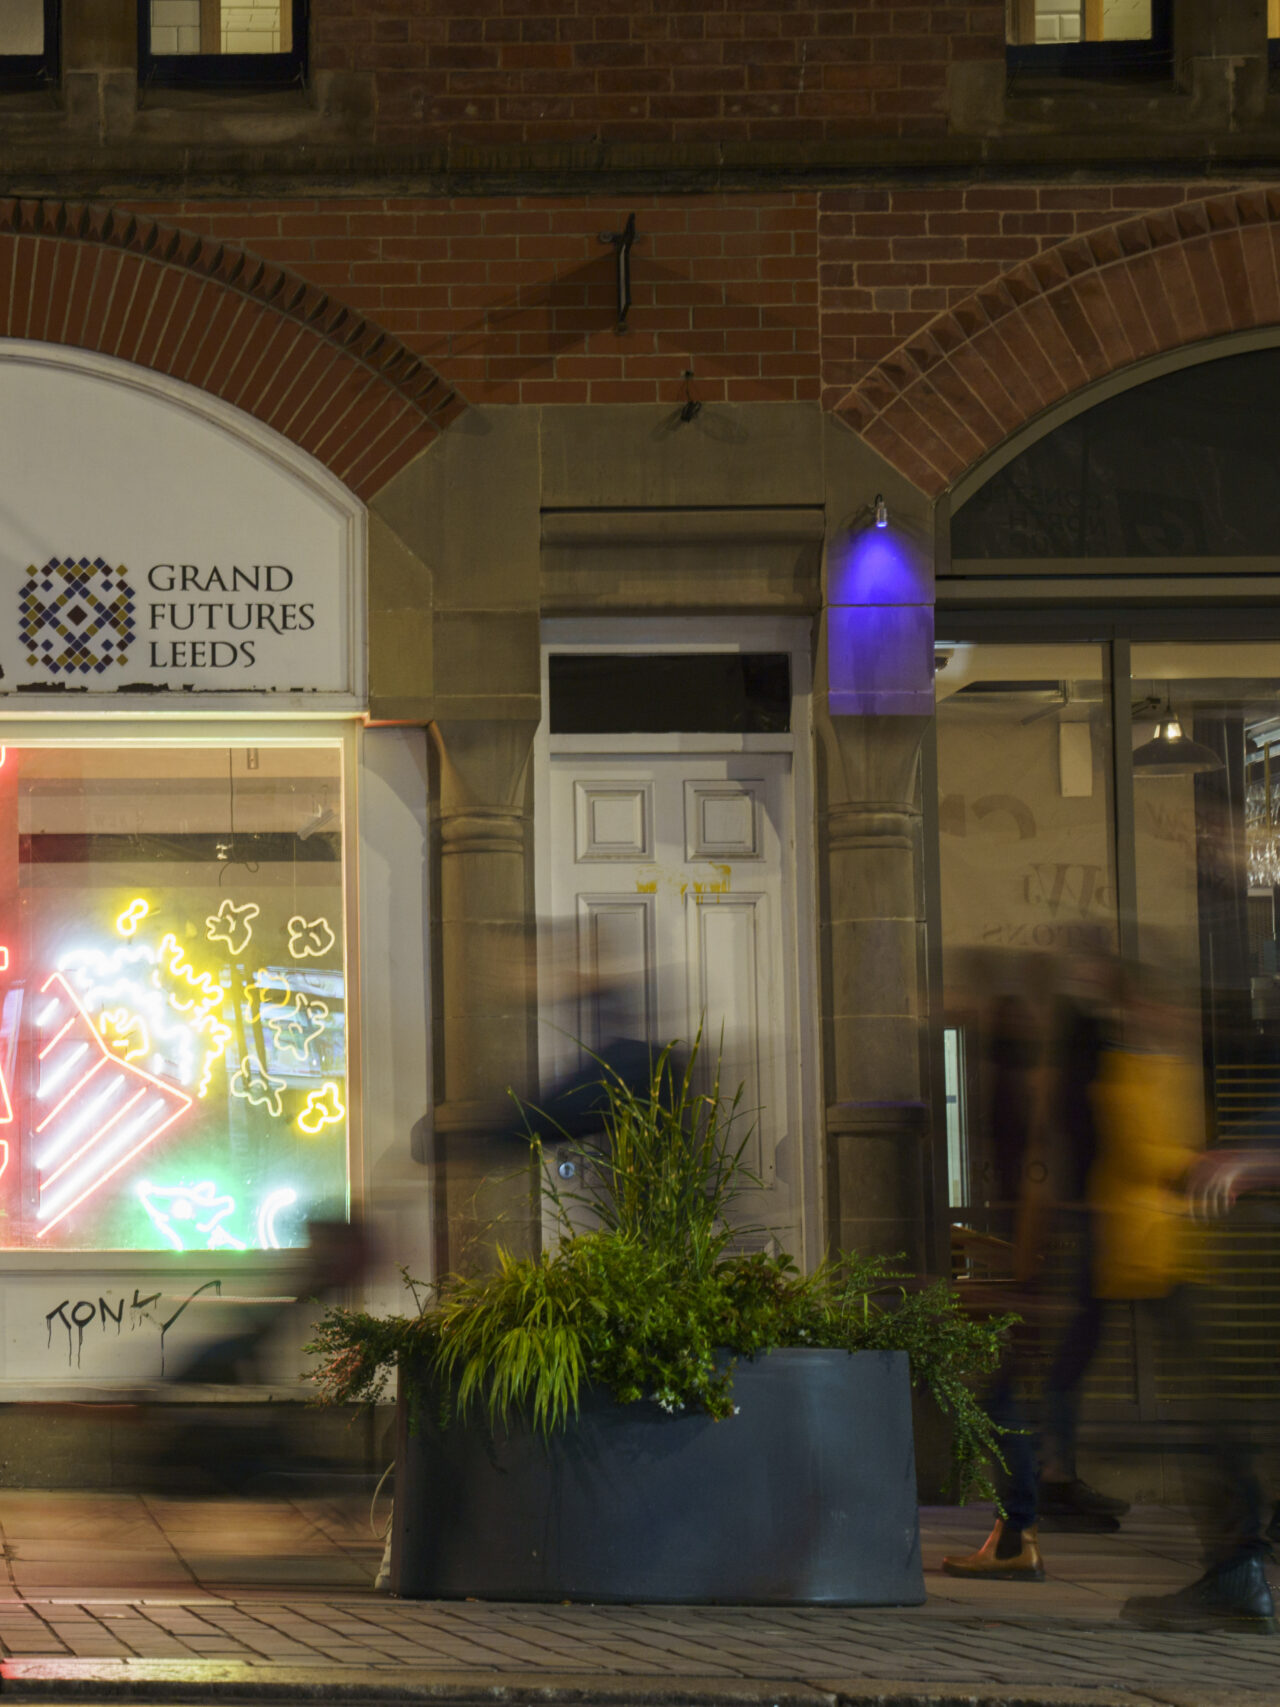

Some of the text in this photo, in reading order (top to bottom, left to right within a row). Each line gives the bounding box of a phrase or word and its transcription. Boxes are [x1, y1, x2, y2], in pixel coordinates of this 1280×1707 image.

[147, 564, 293, 592] GRAND
[148, 603, 315, 636] FUTURES
[149, 640, 256, 668] LEEDS
